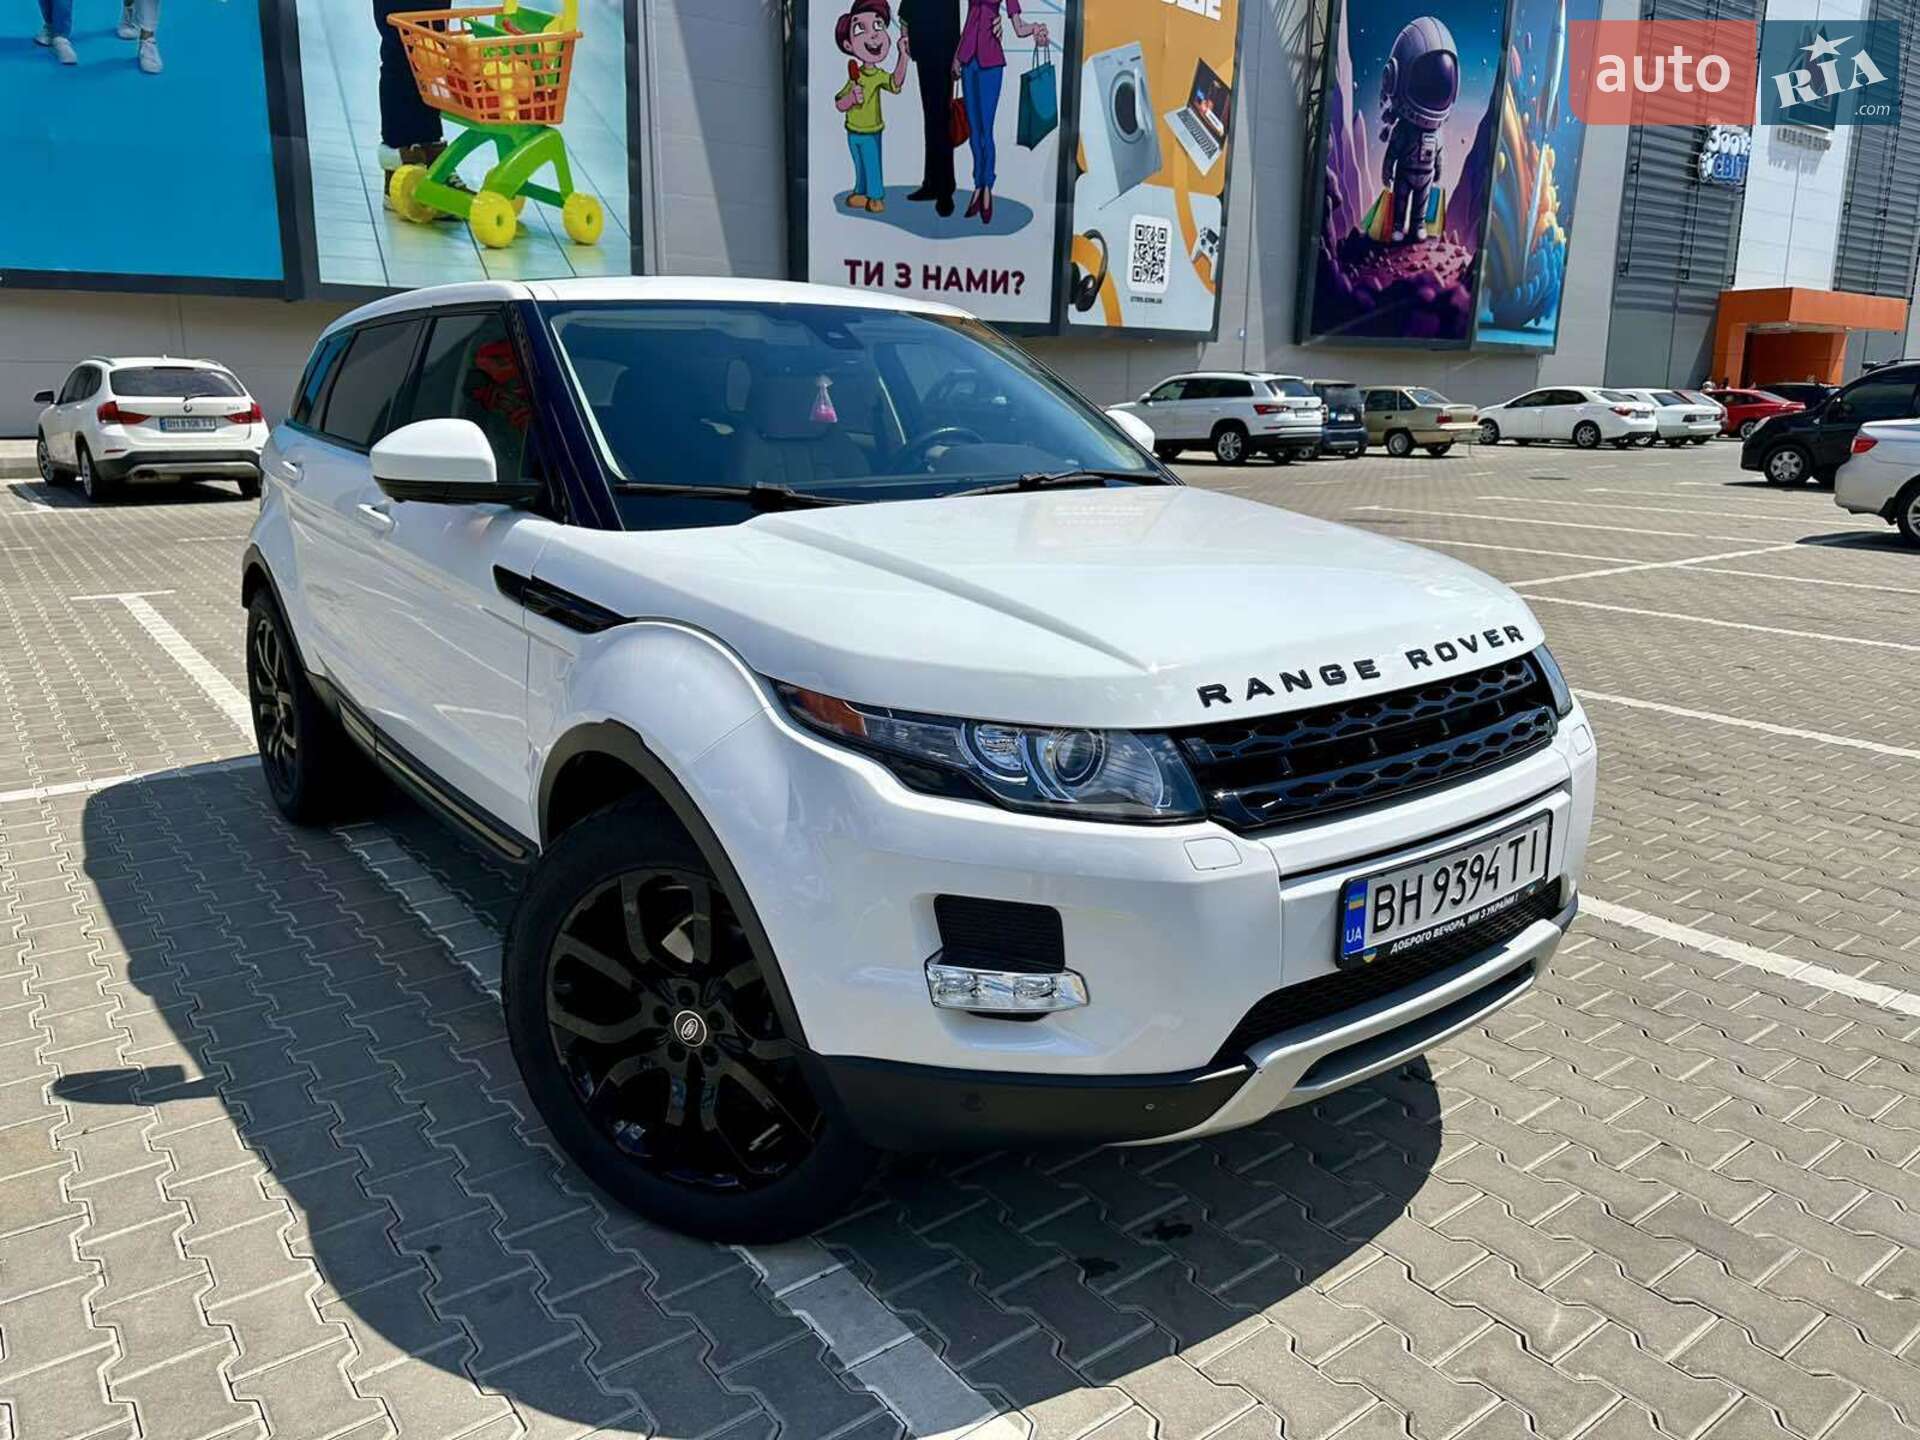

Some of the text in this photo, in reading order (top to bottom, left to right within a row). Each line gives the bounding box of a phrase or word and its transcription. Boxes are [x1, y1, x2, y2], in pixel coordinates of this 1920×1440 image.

[844, 259, 1025, 295] ТИ З НАМИ?
[1197, 625, 1525, 708] RANGE ROVER
[1432, 847, 1500, 915] 9394
[1345, 928, 1363, 943] UA
[1390, 931, 1432, 955] ДОБРОГО
